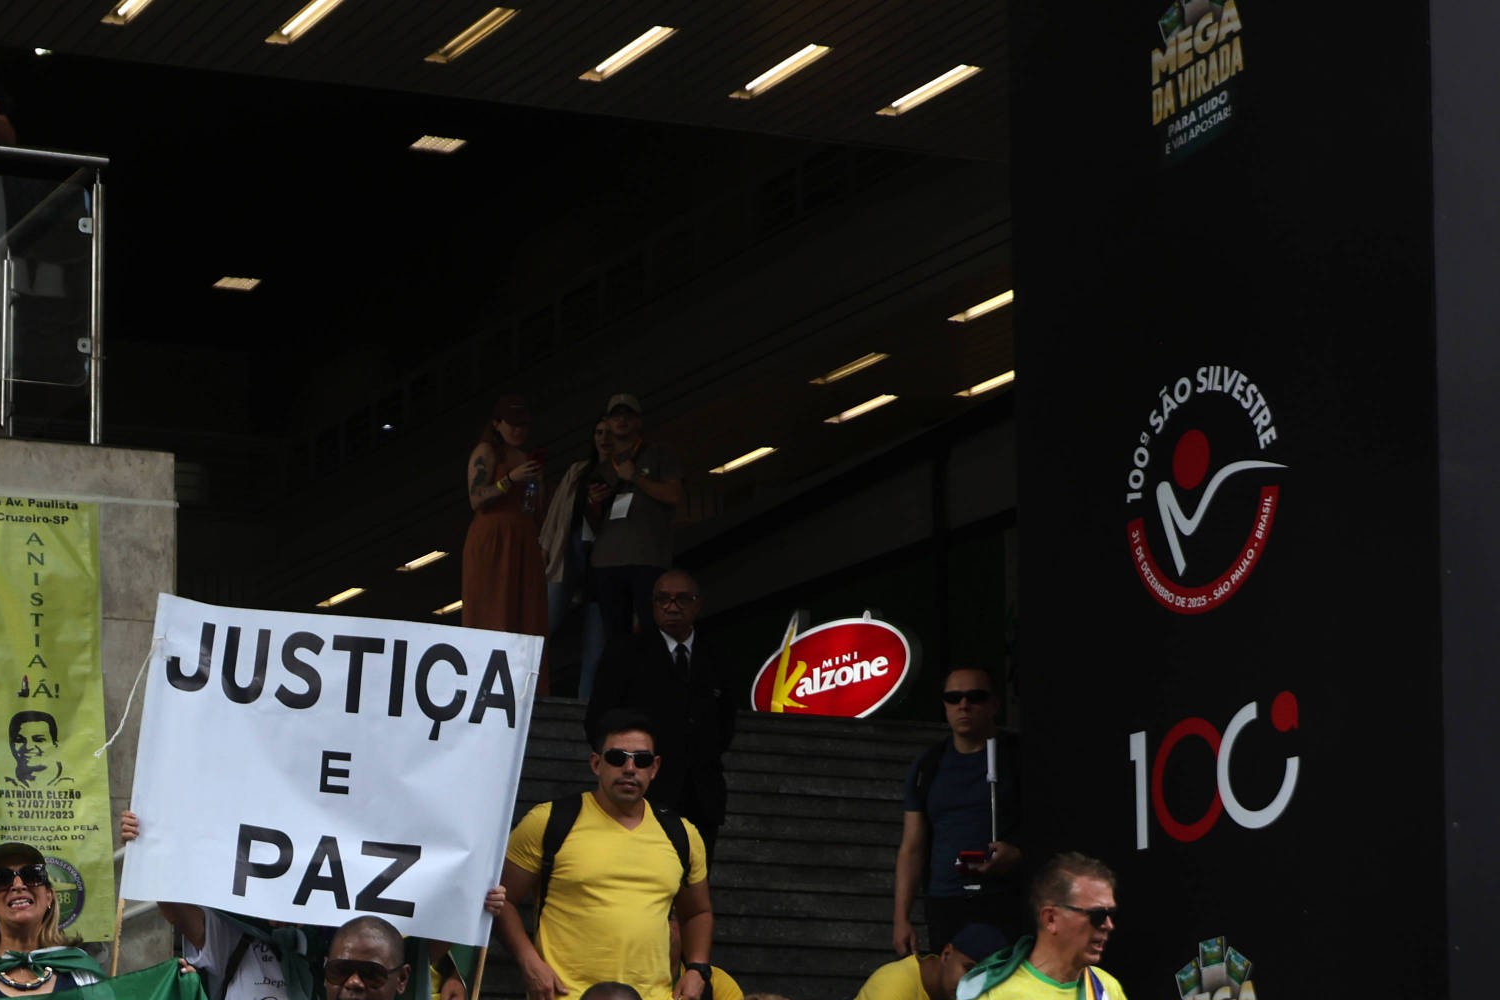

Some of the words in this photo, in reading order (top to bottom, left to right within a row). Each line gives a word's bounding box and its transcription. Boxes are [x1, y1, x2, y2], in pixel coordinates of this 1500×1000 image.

[1152, 0, 1242, 85] MEGA
[1152, 79, 1176, 126] DA
[1177, 36, 1244, 108] VIRADA
[1167, 110, 1196, 137] PARA
[1199, 90, 1229, 118] TUDO
[1149, 377, 1192, 434] SÃO
[1196, 366, 1277, 449] SILVESTRE
[5, 498, 24, 507] Av.
[28, 499, 79, 510] Paulista
[1135, 547, 1146, 563] DE
[1141, 562, 1174, 603] DEZEMBRO
[1175, 596, 1186, 607] DE
[1230, 548, 1255, 584] PAULO
[1255, 495, 1273, 540] BRASIL
[166, 622, 516, 741] JUSTIÇA
[771, 626, 889, 713] Kalzone
[822, 652, 858, 669] MINI
[0, 789, 43, 800] PATRIOTA
[46, 788, 82, 800] CLEZÃO
[319, 750, 352, 795] E
[17, 800, 74, 809] 17/07/1977
[18, 810, 75, 820] 20/11/2023
[0, 834, 68, 842] PACIFICAÇÃO
[232, 824, 422, 918] PAZ
